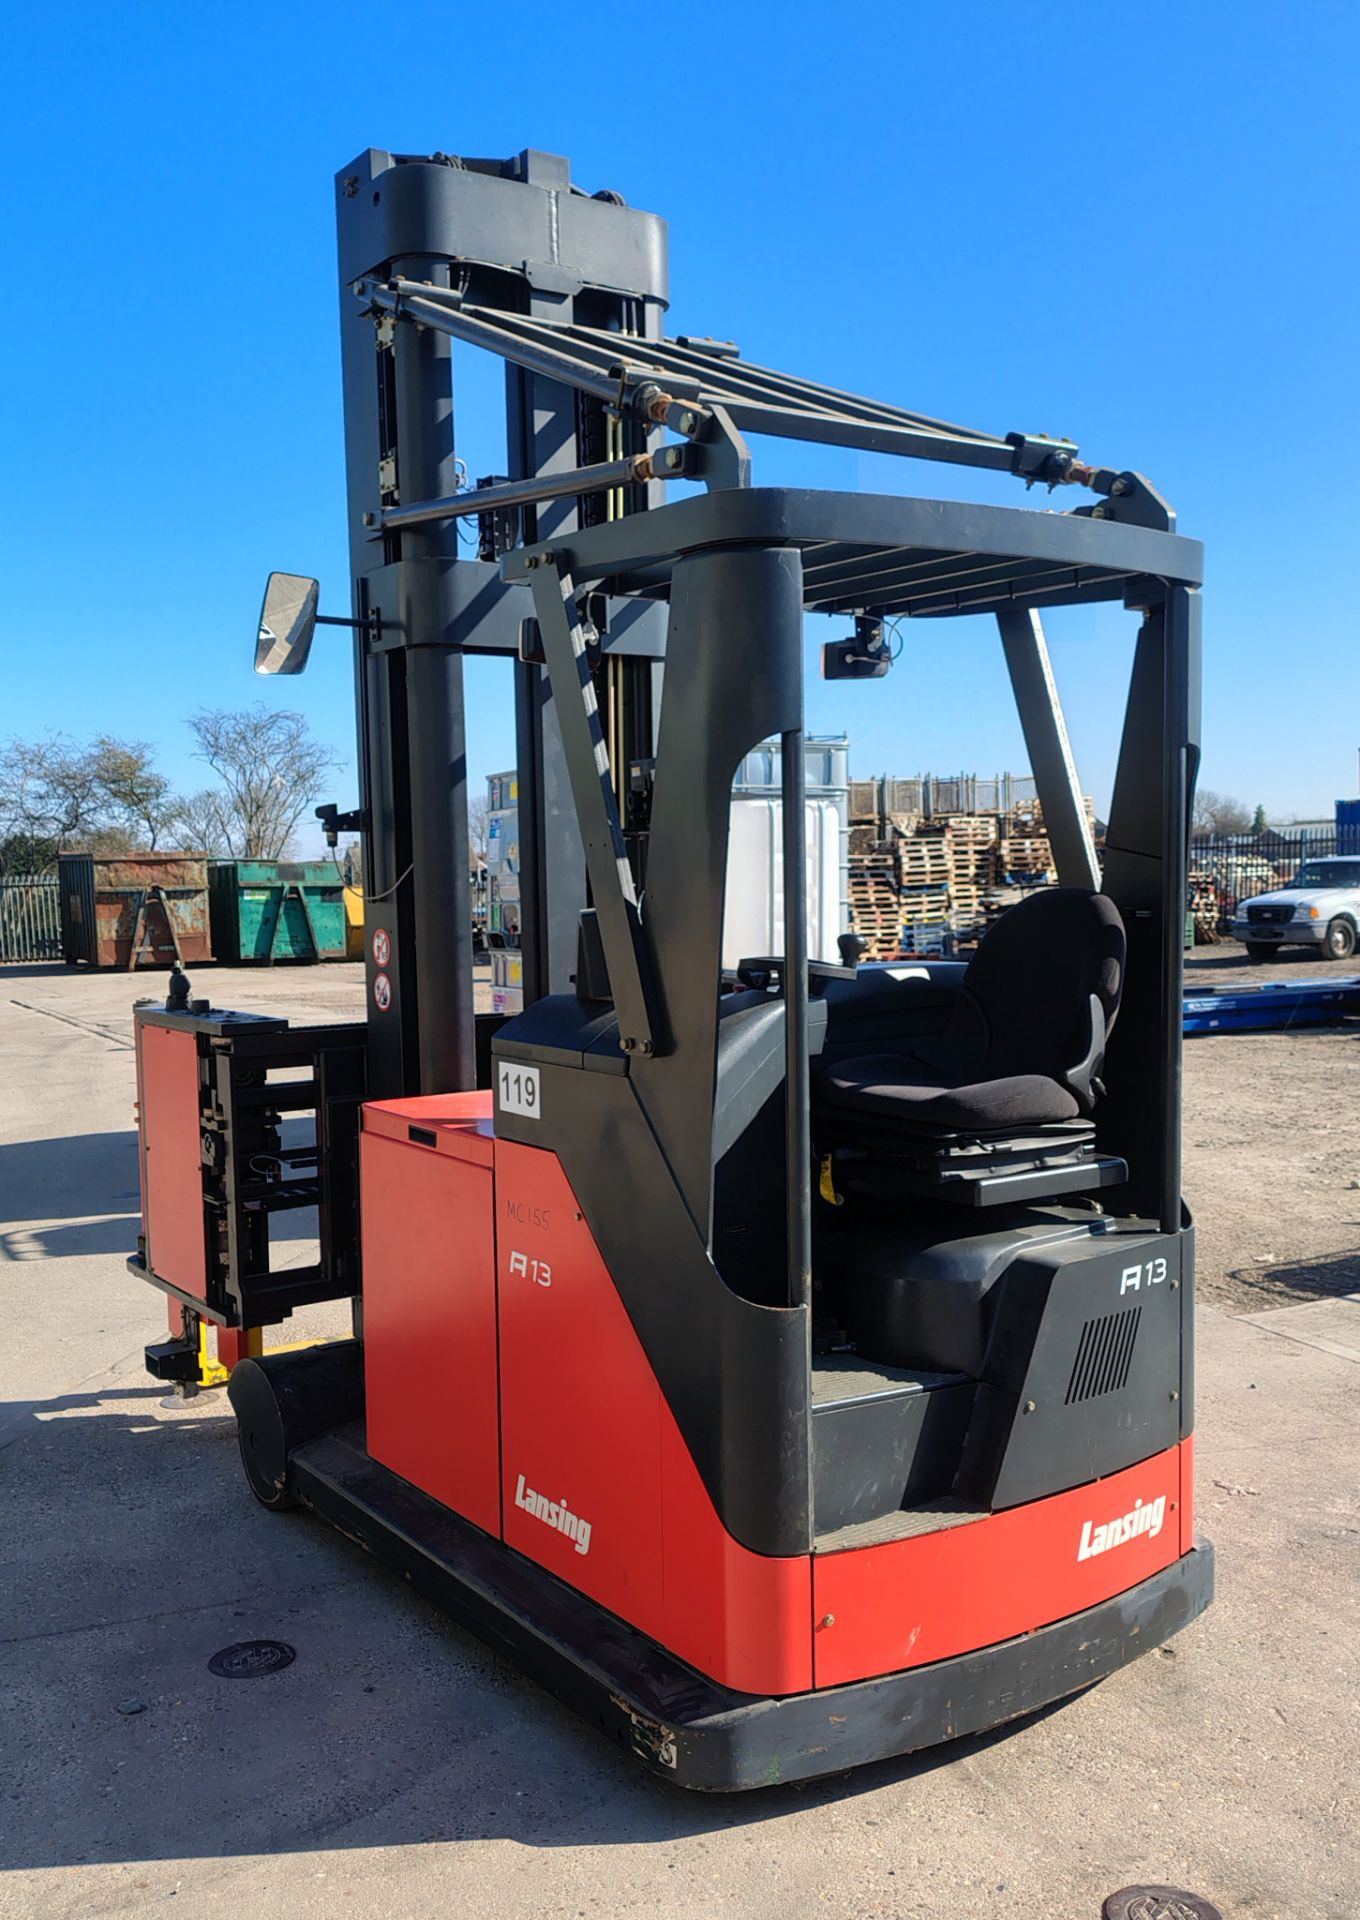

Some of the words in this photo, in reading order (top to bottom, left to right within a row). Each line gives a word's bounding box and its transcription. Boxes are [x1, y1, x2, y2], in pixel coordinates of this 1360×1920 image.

[502, 1071, 536, 1107] 119
[514, 1473, 592, 1556] Lansing
[1076, 1494, 1167, 1563] Lansing
